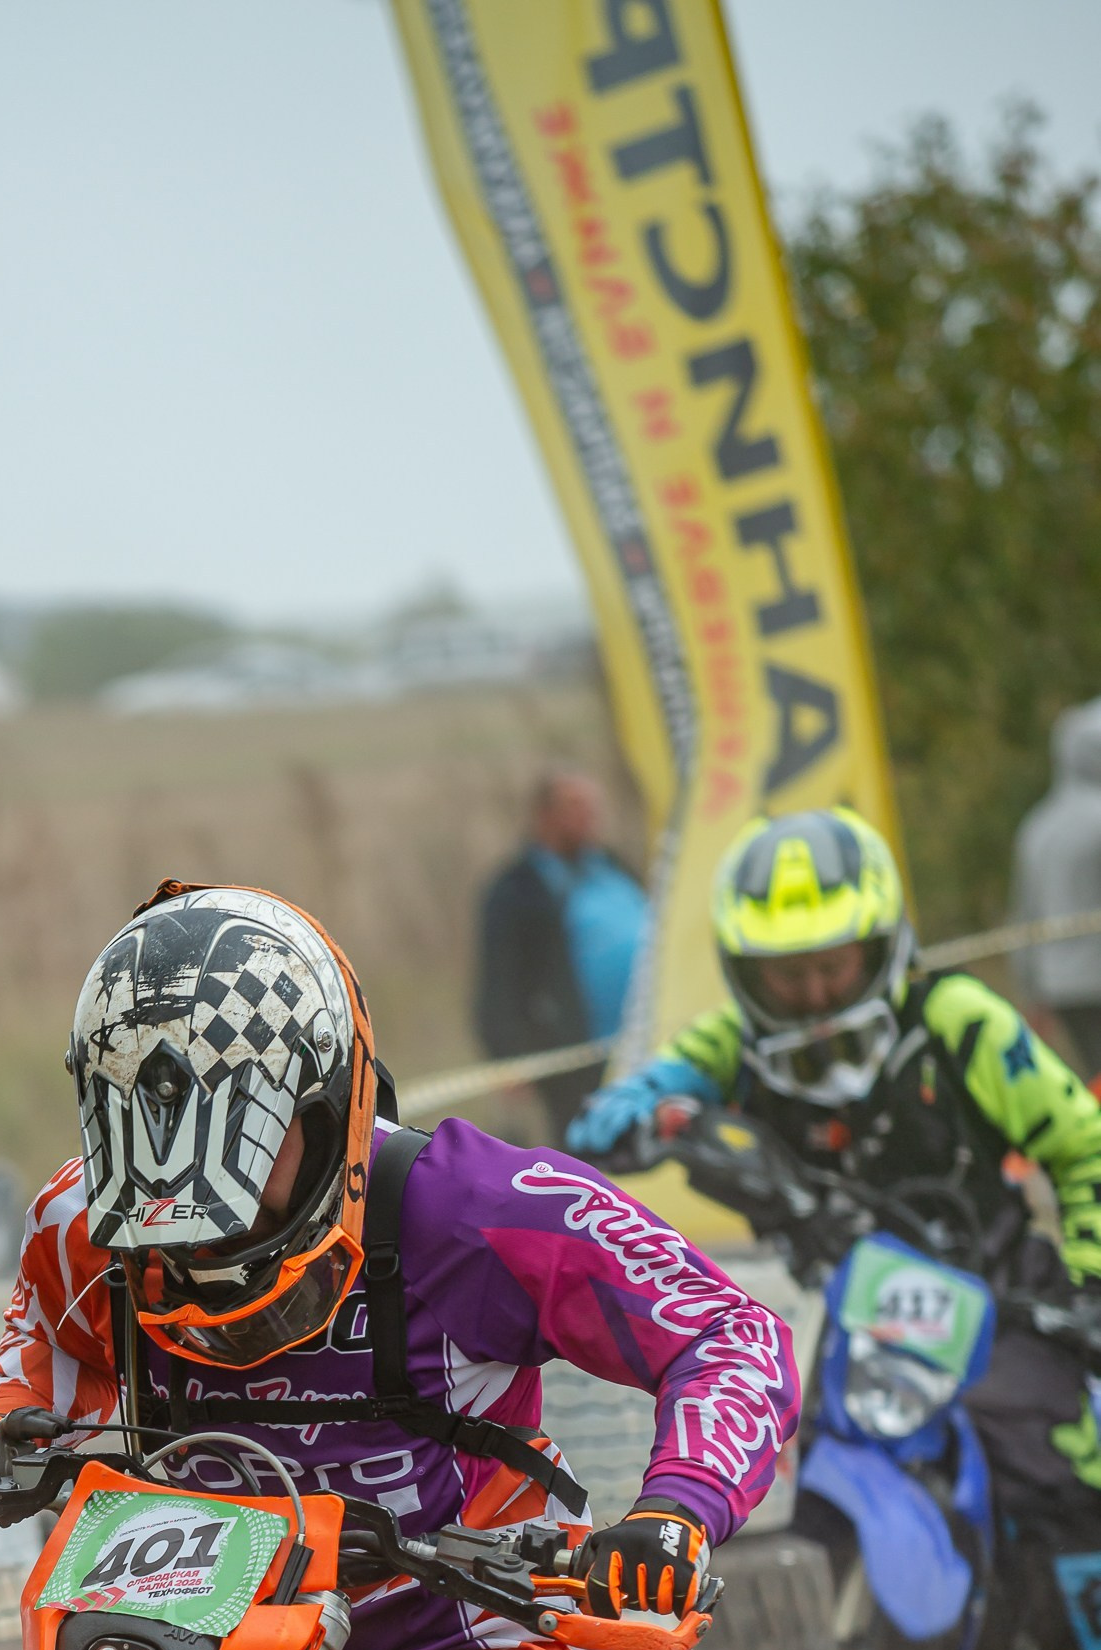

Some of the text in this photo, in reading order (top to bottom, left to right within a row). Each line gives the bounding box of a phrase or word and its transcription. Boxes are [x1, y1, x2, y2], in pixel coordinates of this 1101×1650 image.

[125, 1198, 210, 1227] HIZER
[659, 1520, 683, 1557] KTM
[80, 1521, 225, 1589] 401
[126, 1570, 200, 1588] СЛОБОДСКАЯ
[137, 1578, 203, 1594] БАЛКА 2025
[148, 1586, 214, 1599] ТЕХНОФЕСТ
